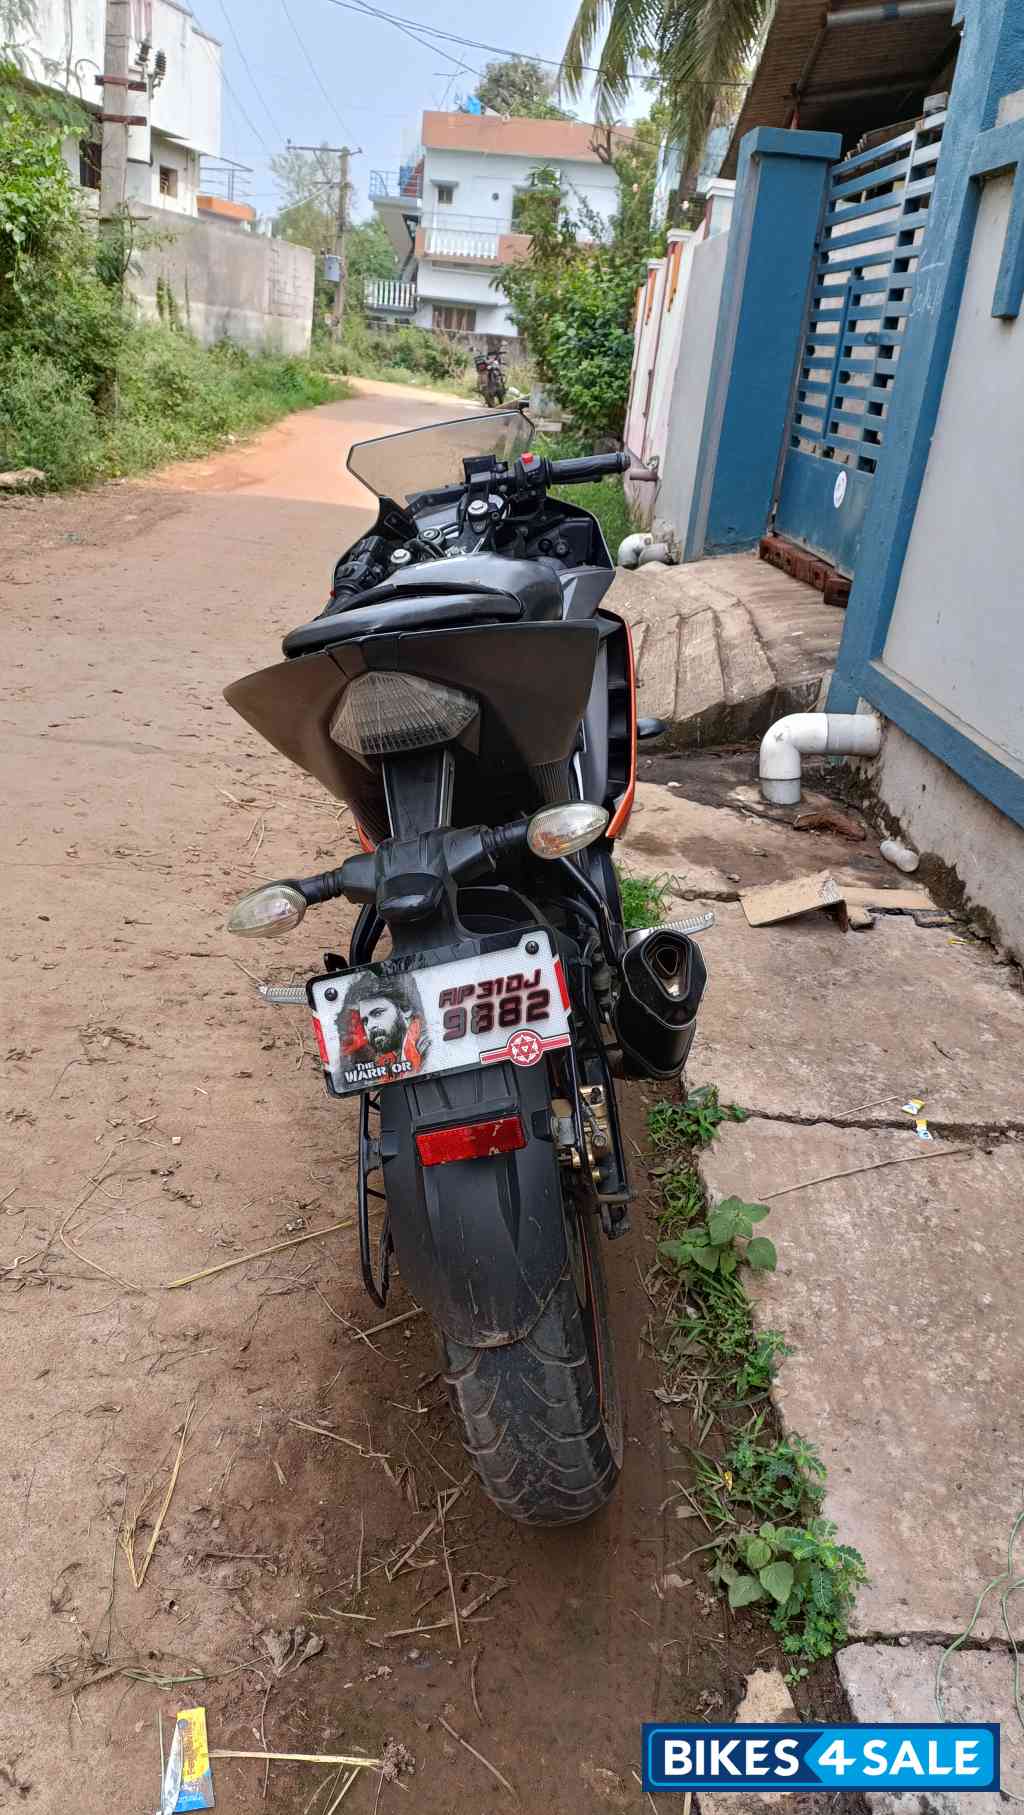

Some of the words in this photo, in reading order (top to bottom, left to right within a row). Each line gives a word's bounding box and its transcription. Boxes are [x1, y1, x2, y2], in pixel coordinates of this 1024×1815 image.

[442, 988, 551, 1041] 9882
[344, 1061, 412, 1083] WARROR
[355, 1061, 375, 1071] THE
